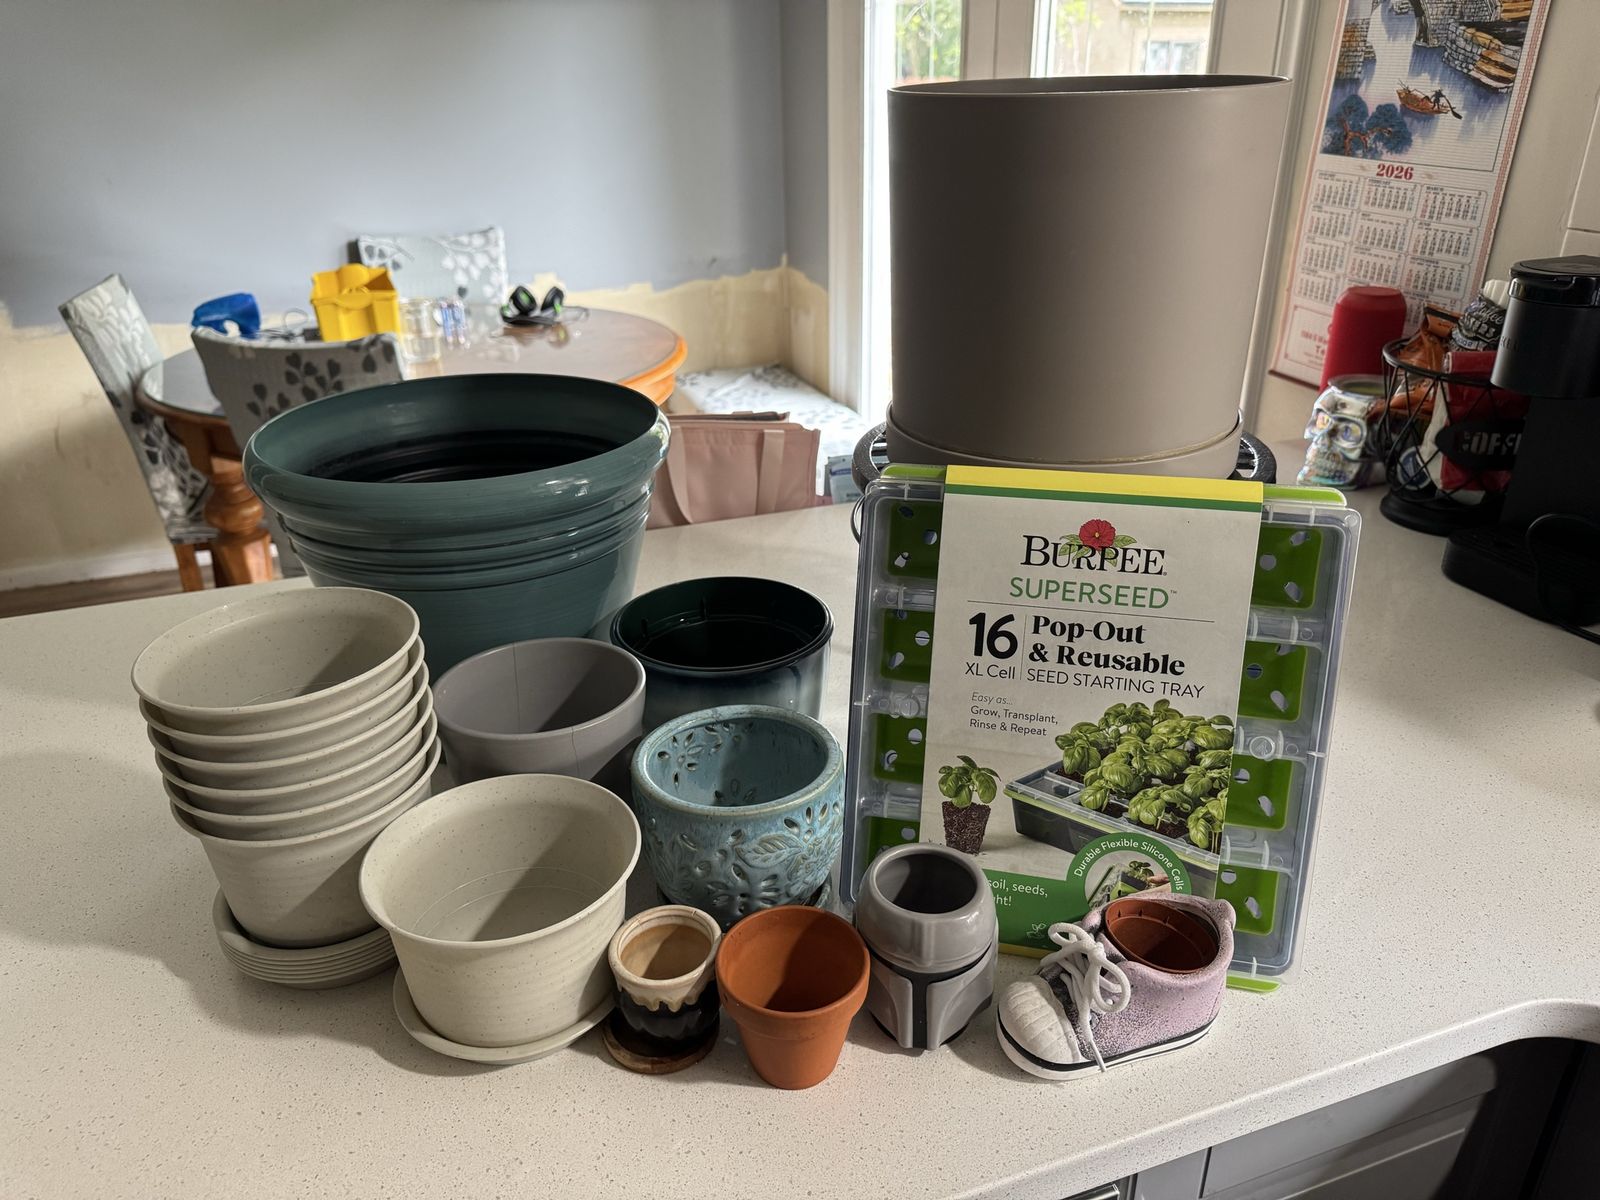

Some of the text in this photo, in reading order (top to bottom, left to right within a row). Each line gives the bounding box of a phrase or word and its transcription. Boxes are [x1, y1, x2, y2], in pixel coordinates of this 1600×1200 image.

[1376, 163, 1414, 180] 2026
[968, 612, 1019, 659] 16
[1032, 615, 1145, 644] Pop-Out
[1028, 643, 1185, 676] & Reusable
[965, 662, 1016, 680] XL Cell
[1027, 668, 1205, 699] SEED STARTING TRAY
[971, 691, 994, 705] Easy
[970, 705, 1059, 725] Grow, Transplant,
[969, 718, 1048, 736] Rinse & Repeat
[1074, 839, 1184, 891] Durable Flexible Silicone Cells
[1012, 883, 1048, 898] seeds,
[993, 894, 1012, 907] ht!
